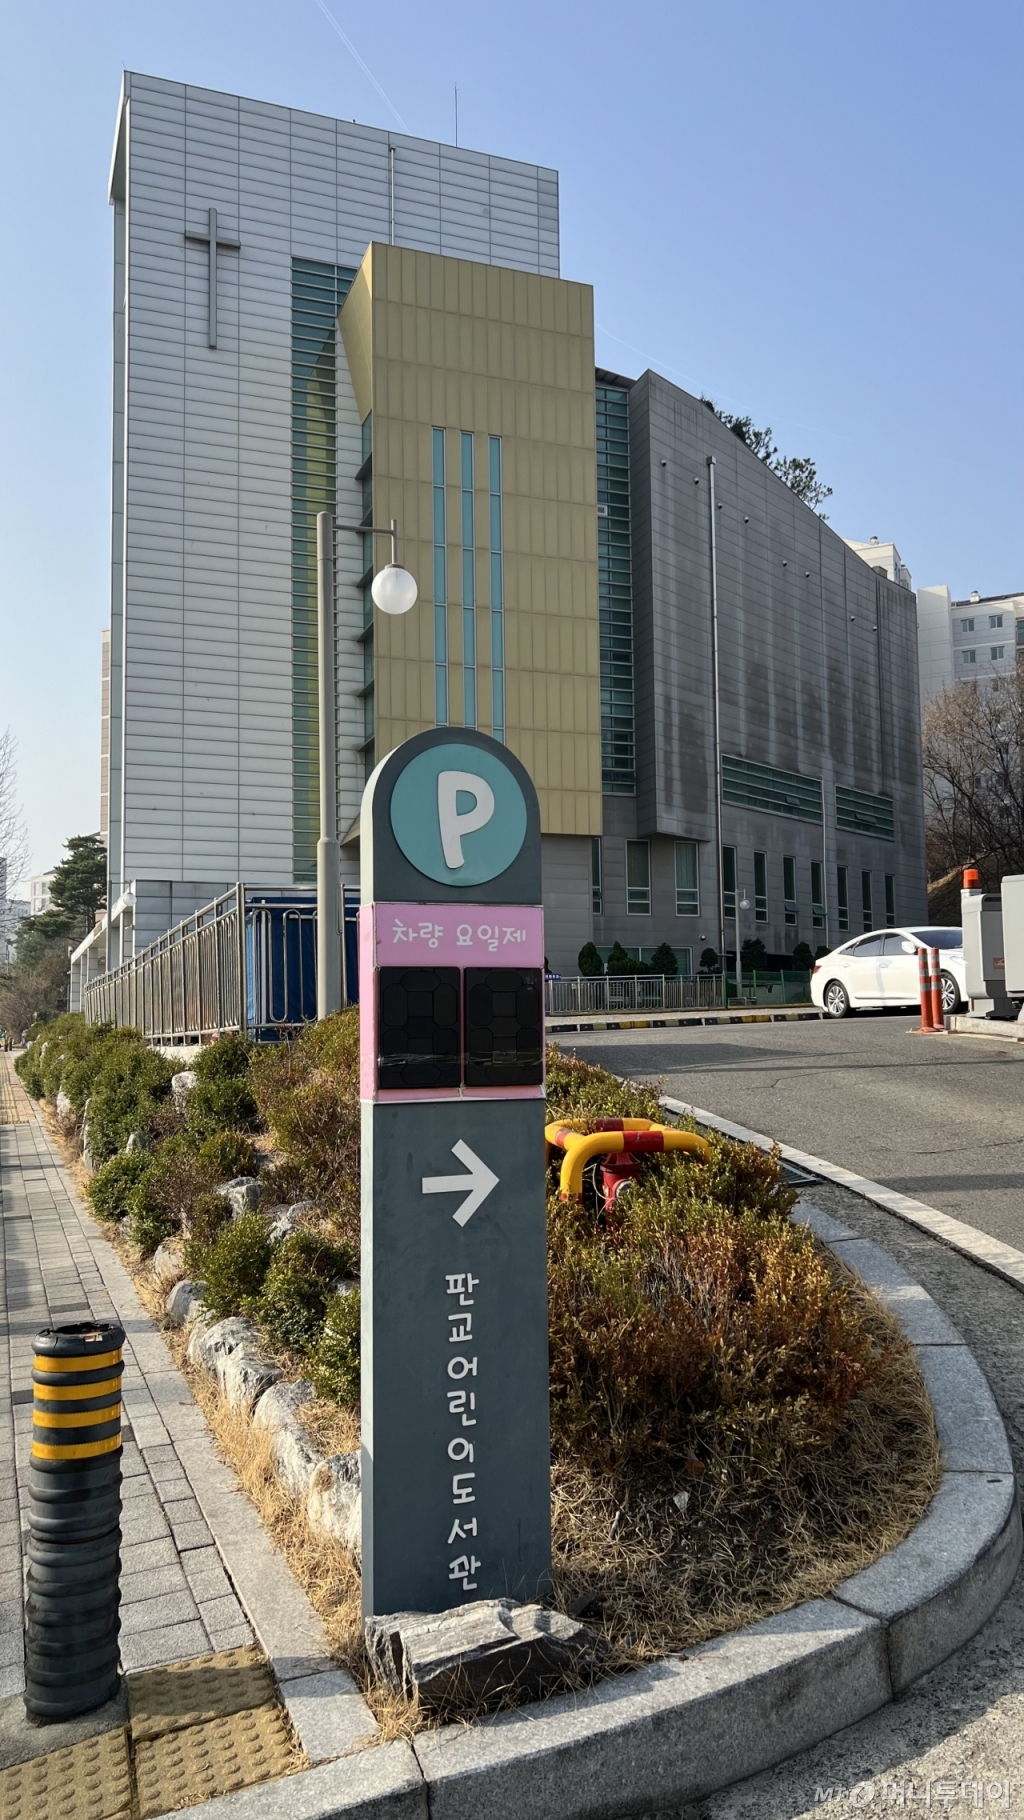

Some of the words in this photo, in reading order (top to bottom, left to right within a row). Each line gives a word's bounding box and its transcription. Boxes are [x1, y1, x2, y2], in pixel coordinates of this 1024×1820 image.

[437, 770, 495, 869] P
[392, 918, 444, 949] 차량
[456, 924, 526, 952] 요일제
[445, 1272, 481, 1591] 판교어린이도서관
